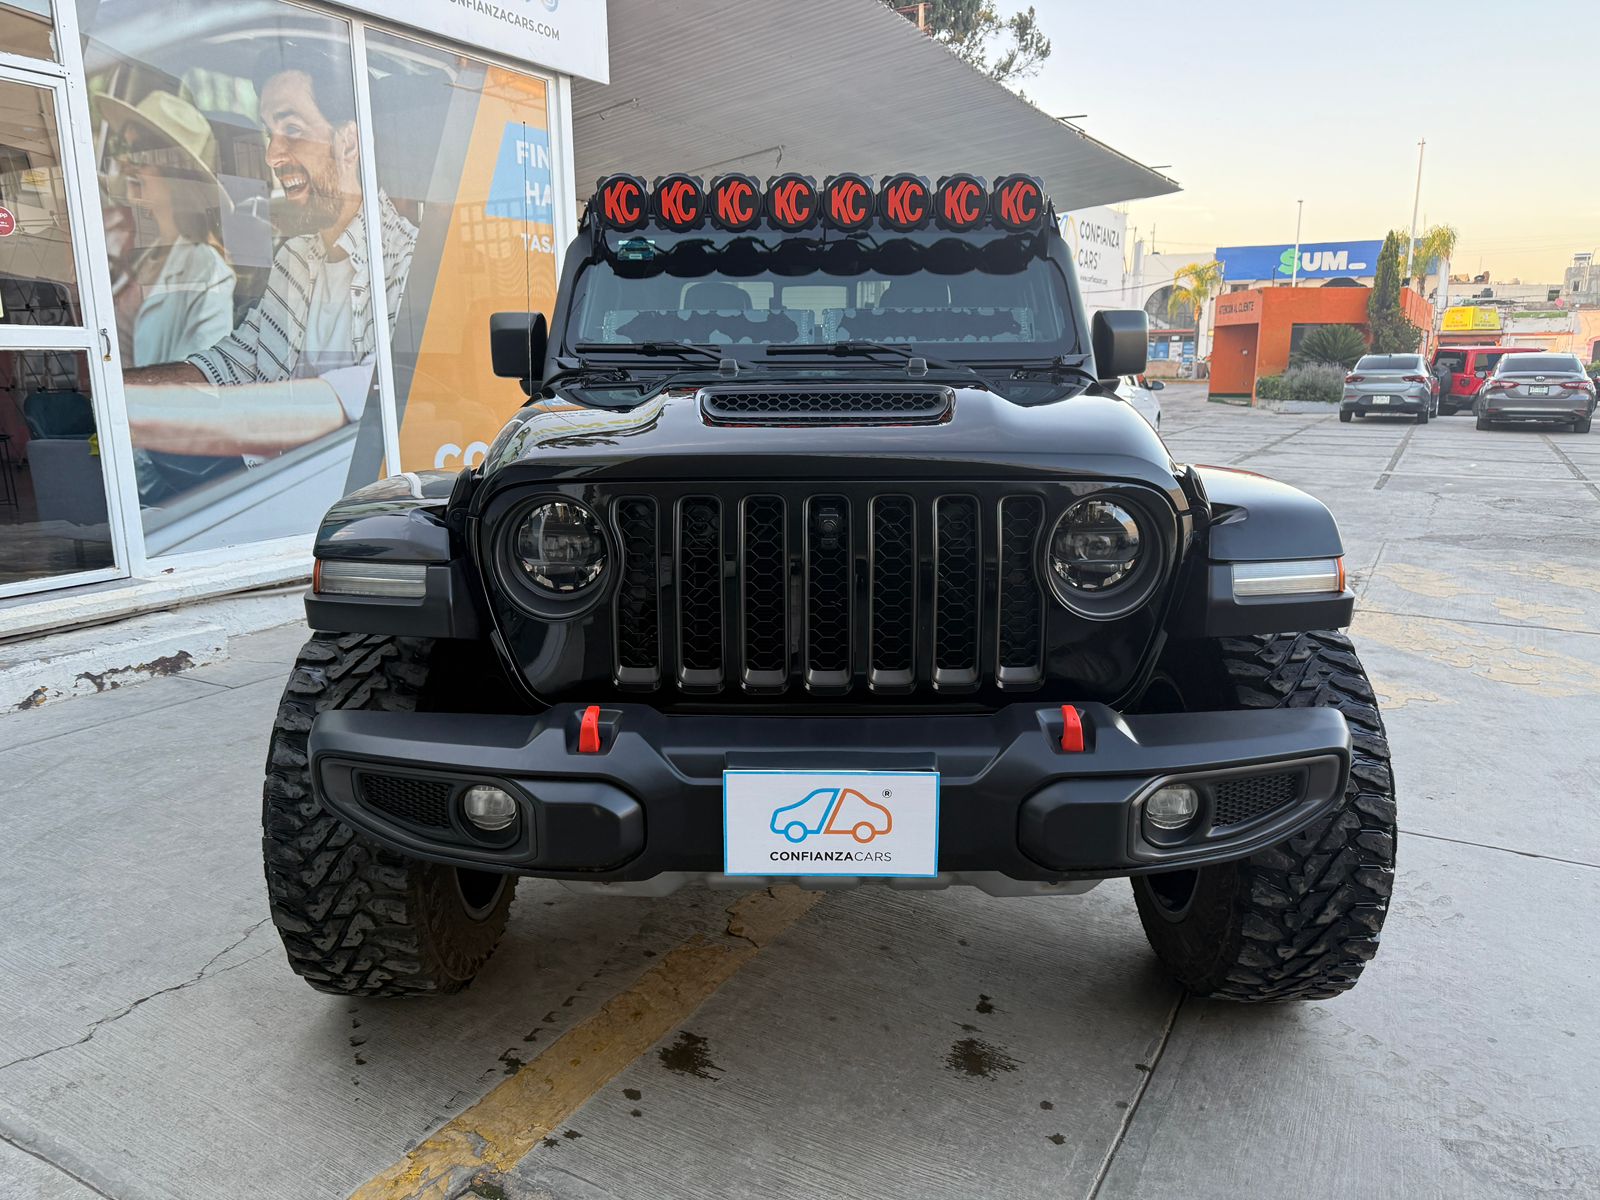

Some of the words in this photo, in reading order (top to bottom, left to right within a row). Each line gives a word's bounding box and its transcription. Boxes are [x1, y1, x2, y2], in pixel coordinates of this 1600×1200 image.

[450, 0, 560, 41] FIANZACARS.COM
[604, 181, 640, 224] KC
[661, 181, 697, 224] KC
[718, 181, 753, 224] KC
[774, 181, 810, 224] KC
[831, 181, 866, 224] KC
[887, 181, 923, 224] KC
[944, 181, 980, 224] KC
[1001, 181, 1037, 224] KC
[520, 233, 555, 254] TAS
[1080, 220, 1120, 249] CONFIANZA
[1078, 248, 1098, 270] CARS
[769, 851, 892, 862] CONFIANZACARS
